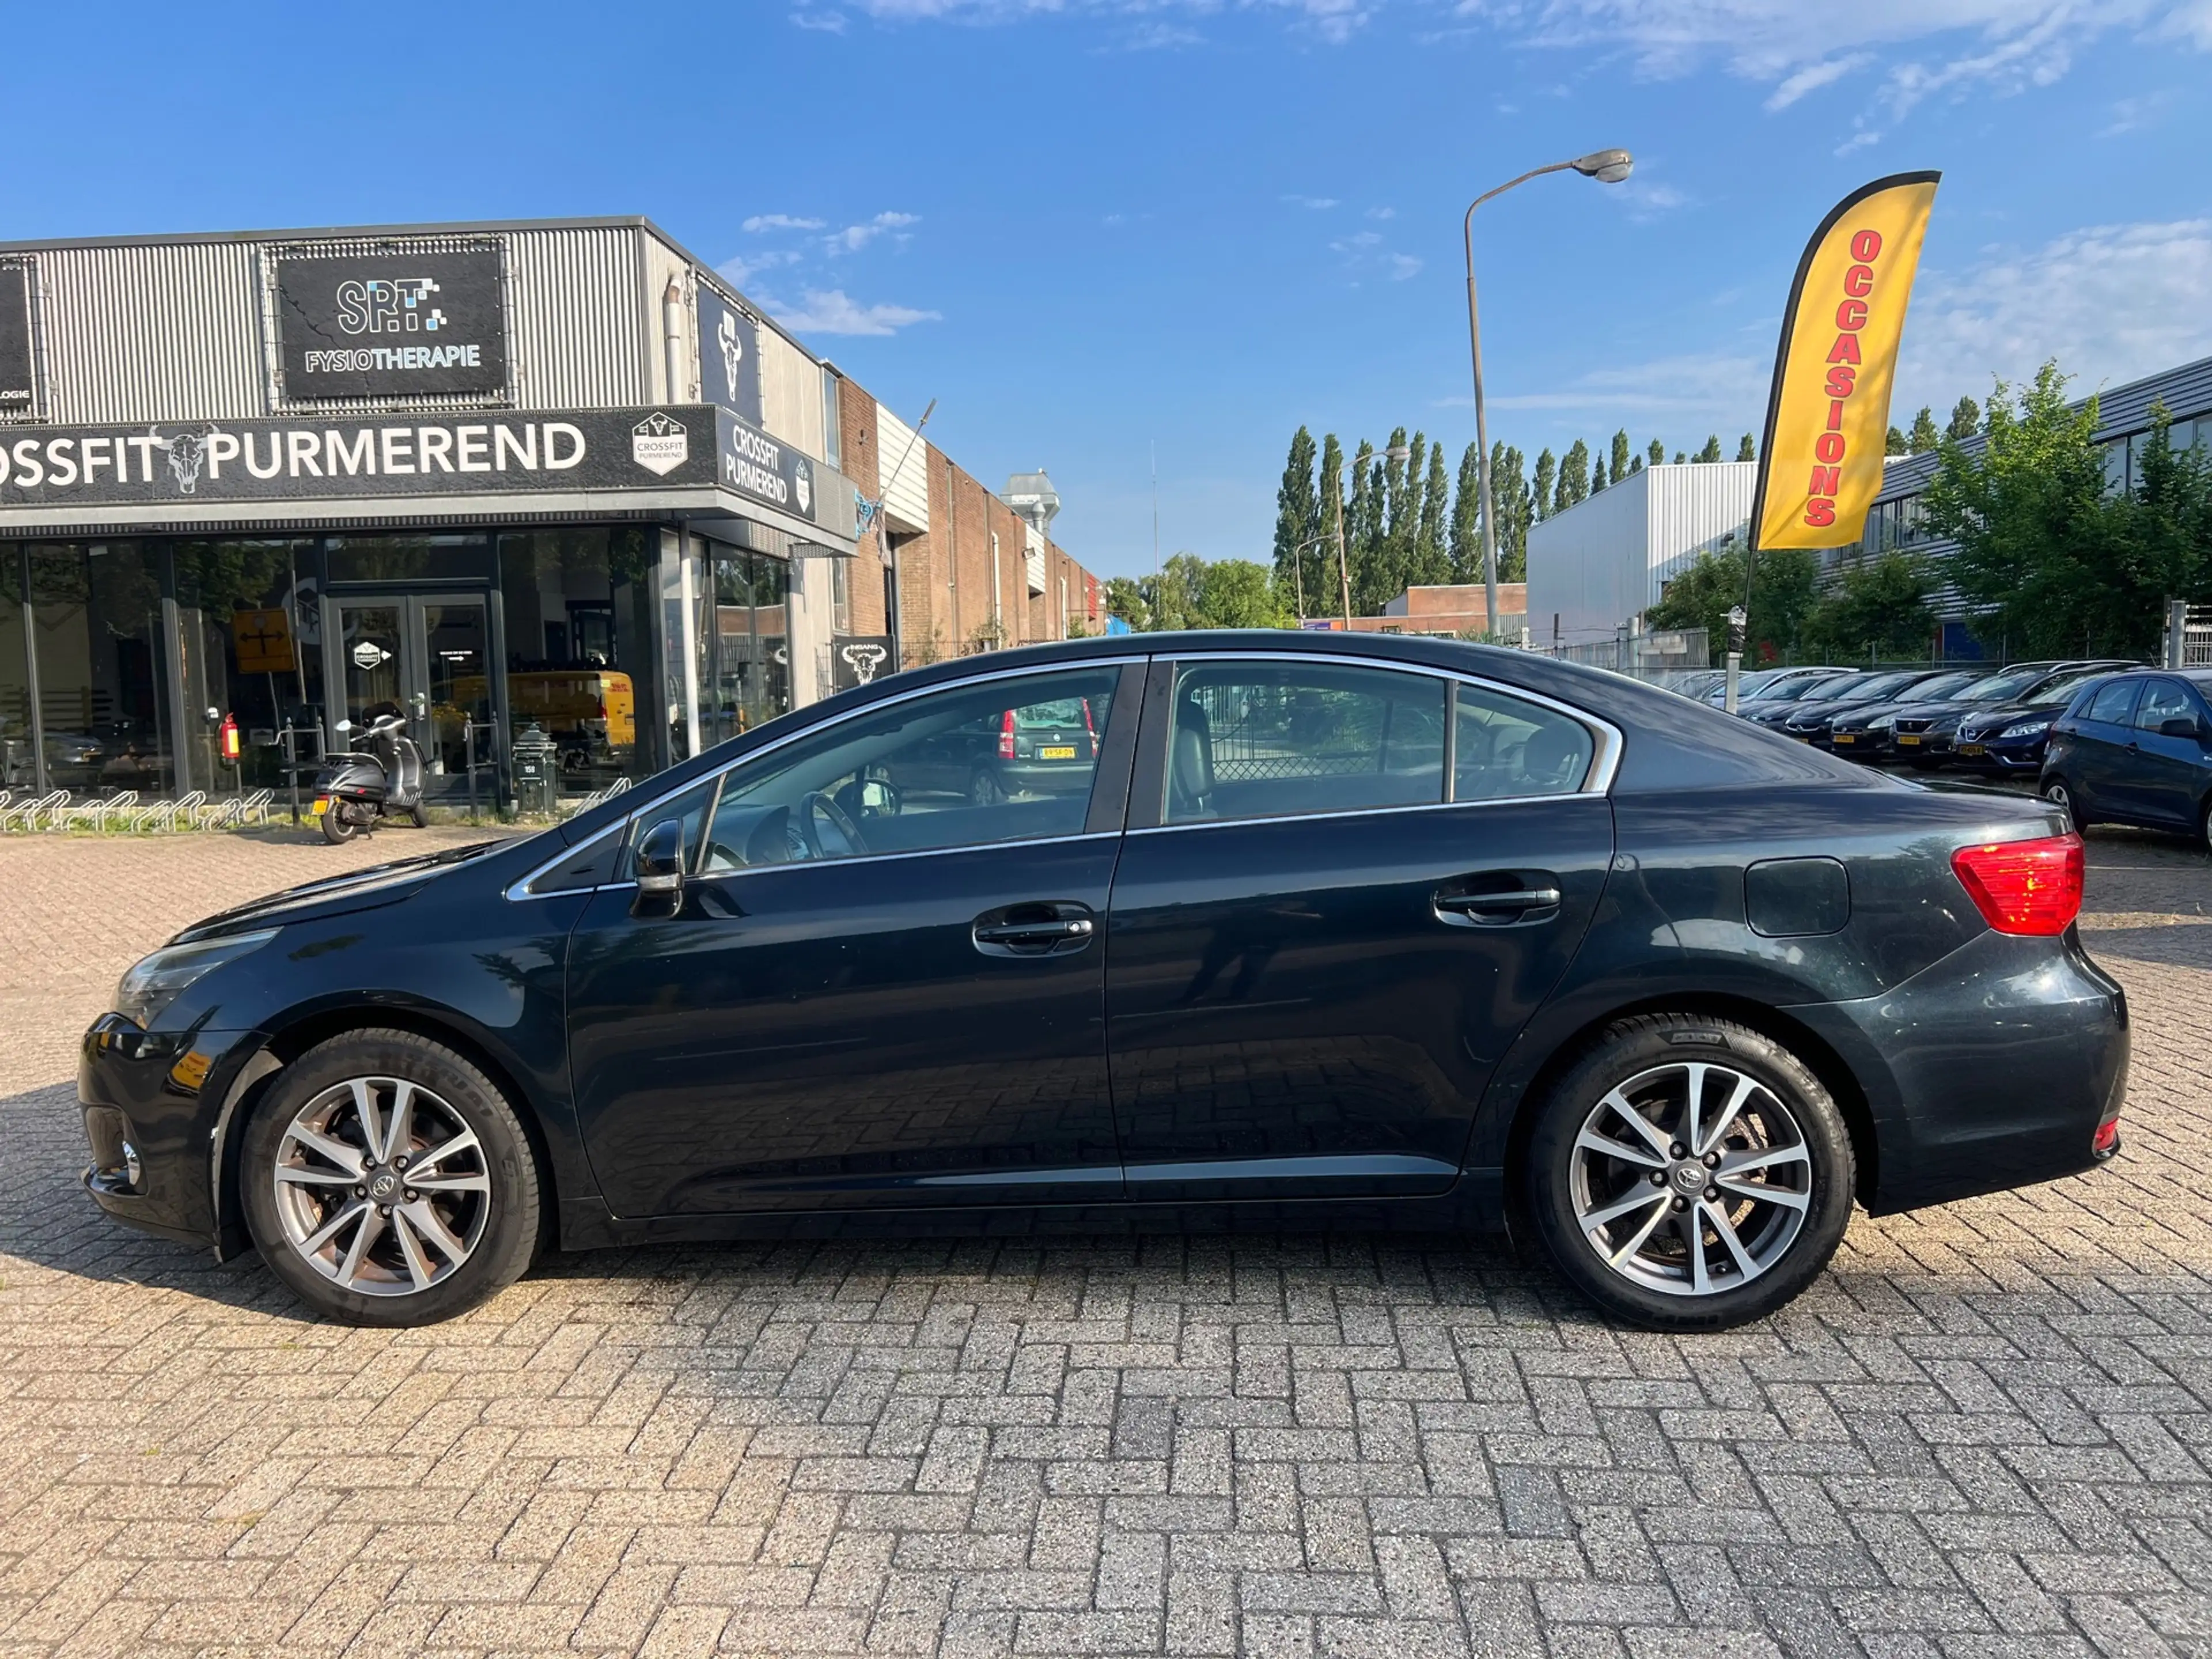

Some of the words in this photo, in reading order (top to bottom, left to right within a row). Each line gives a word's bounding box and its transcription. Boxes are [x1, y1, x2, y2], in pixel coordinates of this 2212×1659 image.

[337, 278, 433, 334] SRT
[305, 344, 481, 373] FYSIOTHERAPIE
[1804, 229, 1882, 527] OCCASIONS
[0, 390, 30, 399] OGIE
[207, 422, 586, 479] PURMEREND
[637, 442, 684, 452] CROSSFIT
[733, 425, 779, 471] CROSSFIT
[726, 453, 788, 505] PURMEREND
